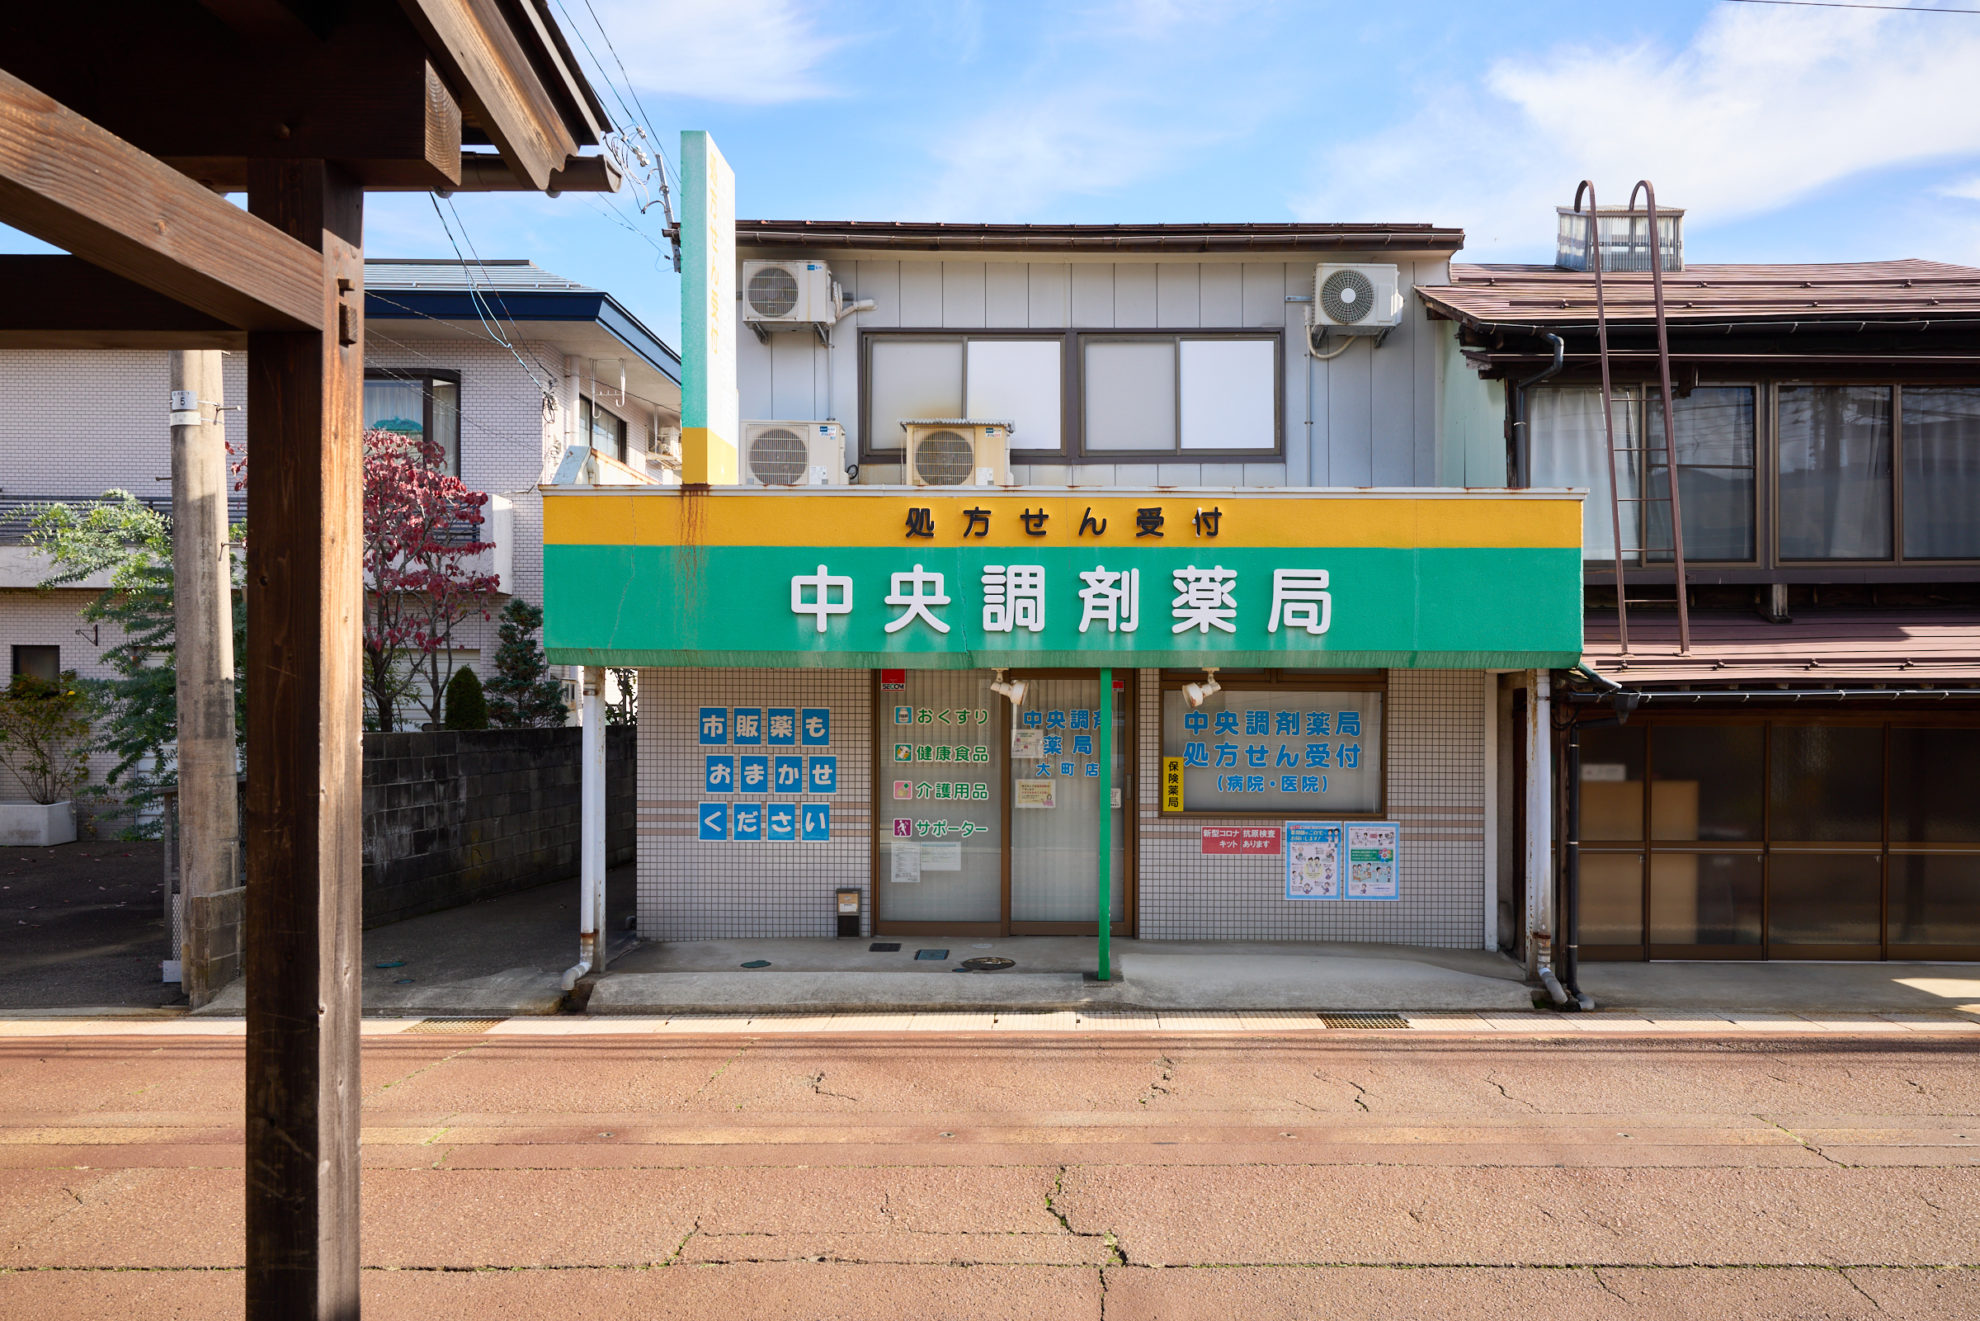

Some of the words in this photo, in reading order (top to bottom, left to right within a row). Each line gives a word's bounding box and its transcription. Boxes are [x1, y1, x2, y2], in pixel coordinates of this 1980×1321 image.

[905, 506, 1223, 538] 処方せん受付
[791, 563, 1332, 635] 中央調剤薬局
[882, 683, 905, 691] SECOM
[702, 714, 826, 738] 市販薬も
[917, 708, 988, 725] おくすり
[1184, 710, 1362, 736] 中央調剤薬局
[916, 745, 989, 762] 健康食品
[1043, 735, 1092, 755] 薬局
[1183, 742, 1361, 769] 処方せん受付
[709, 763, 833, 785] おまかせ
[1036, 762, 1099, 777] 大町店
[916, 781, 989, 799] 介護用品
[1167, 760, 1179, 808] 保険薬局
[1217, 775, 1328, 793] (病院・医院)
[704, 811, 826, 832] ください
[916, 819, 988, 836] サポーター
